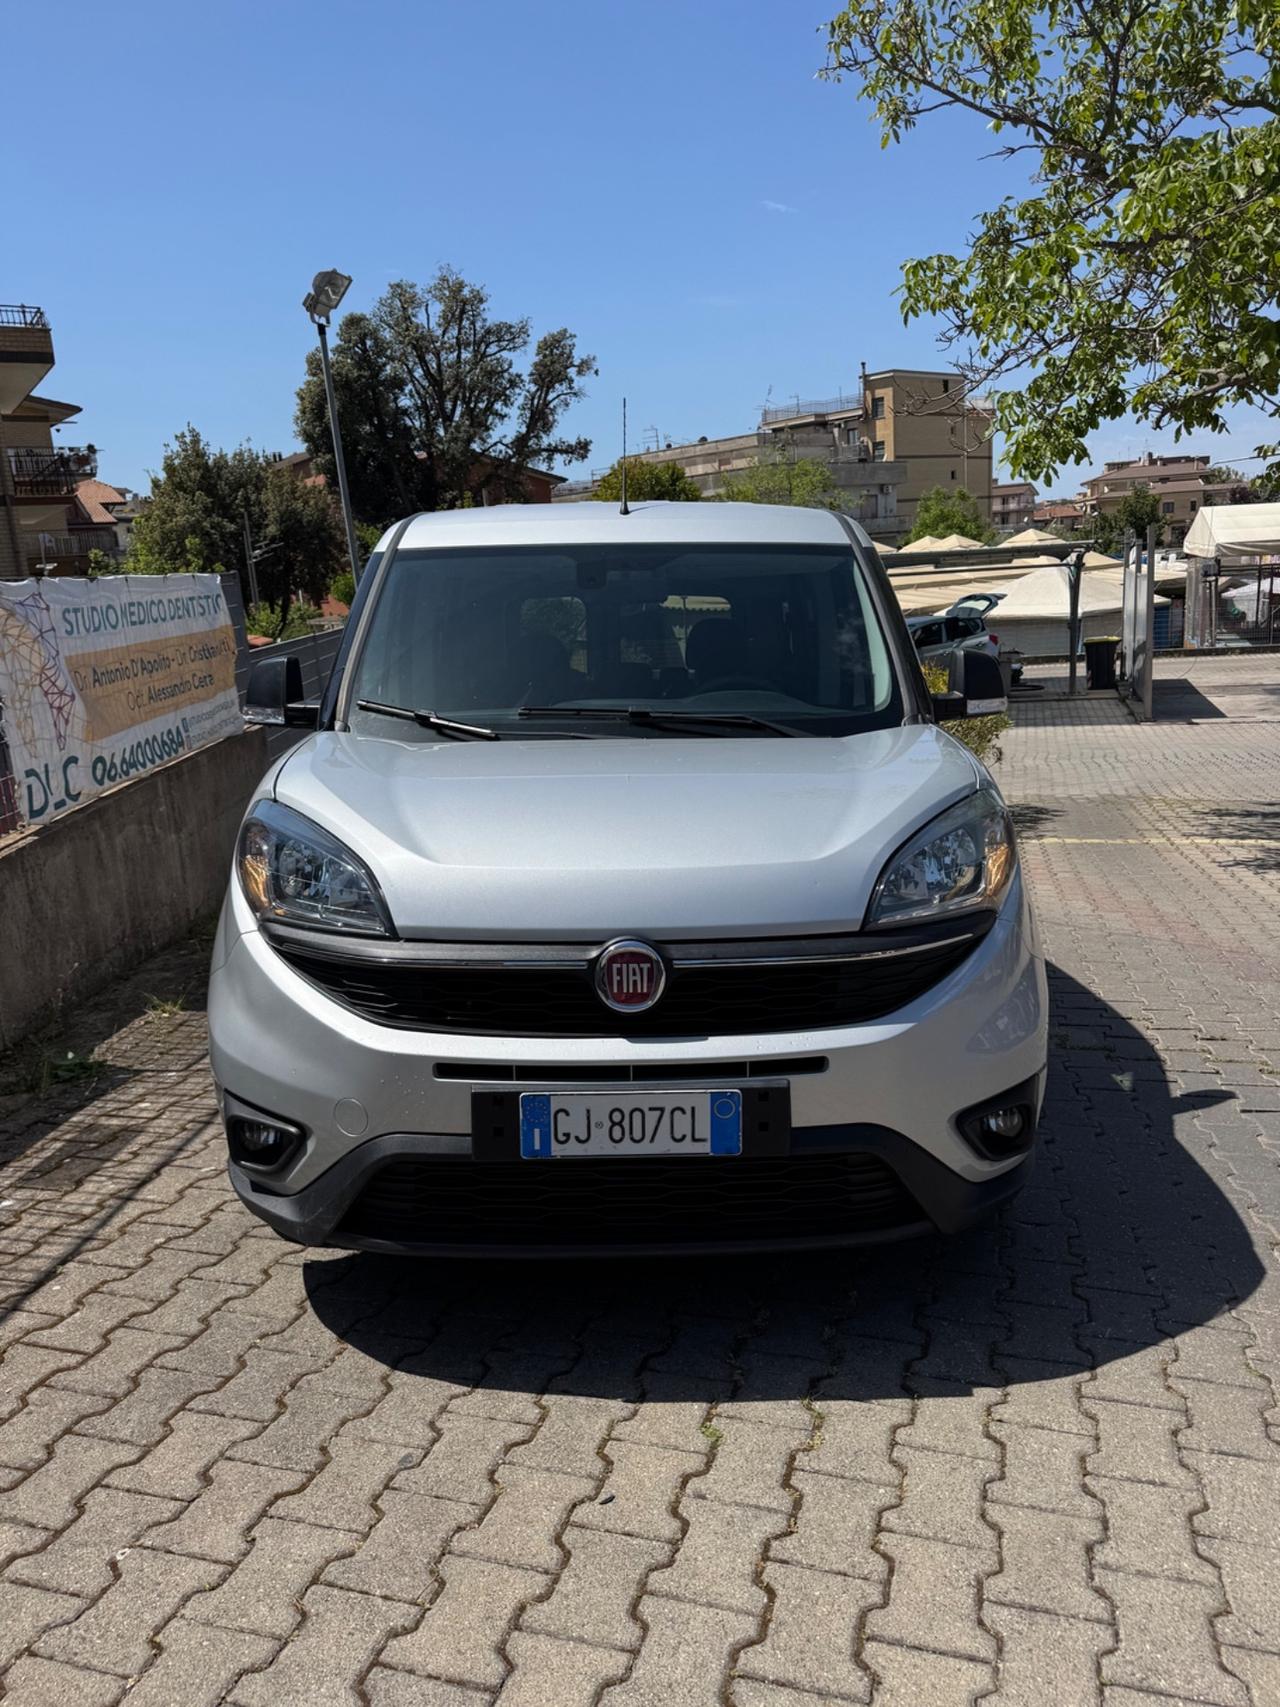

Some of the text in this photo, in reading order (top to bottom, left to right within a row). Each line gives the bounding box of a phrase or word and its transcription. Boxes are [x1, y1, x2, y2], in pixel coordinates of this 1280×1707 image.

[62, 603, 119, 636] STUDIO
[120, 598, 167, 629] MEDICO
[92, 661, 131, 689] Antonio
[92, 724, 185, 787] 06.64000684
[611, 962, 652, 993] FIAT
[553, 1107, 592, 1145] GJ
[607, 1105, 708, 1145] 807CL
